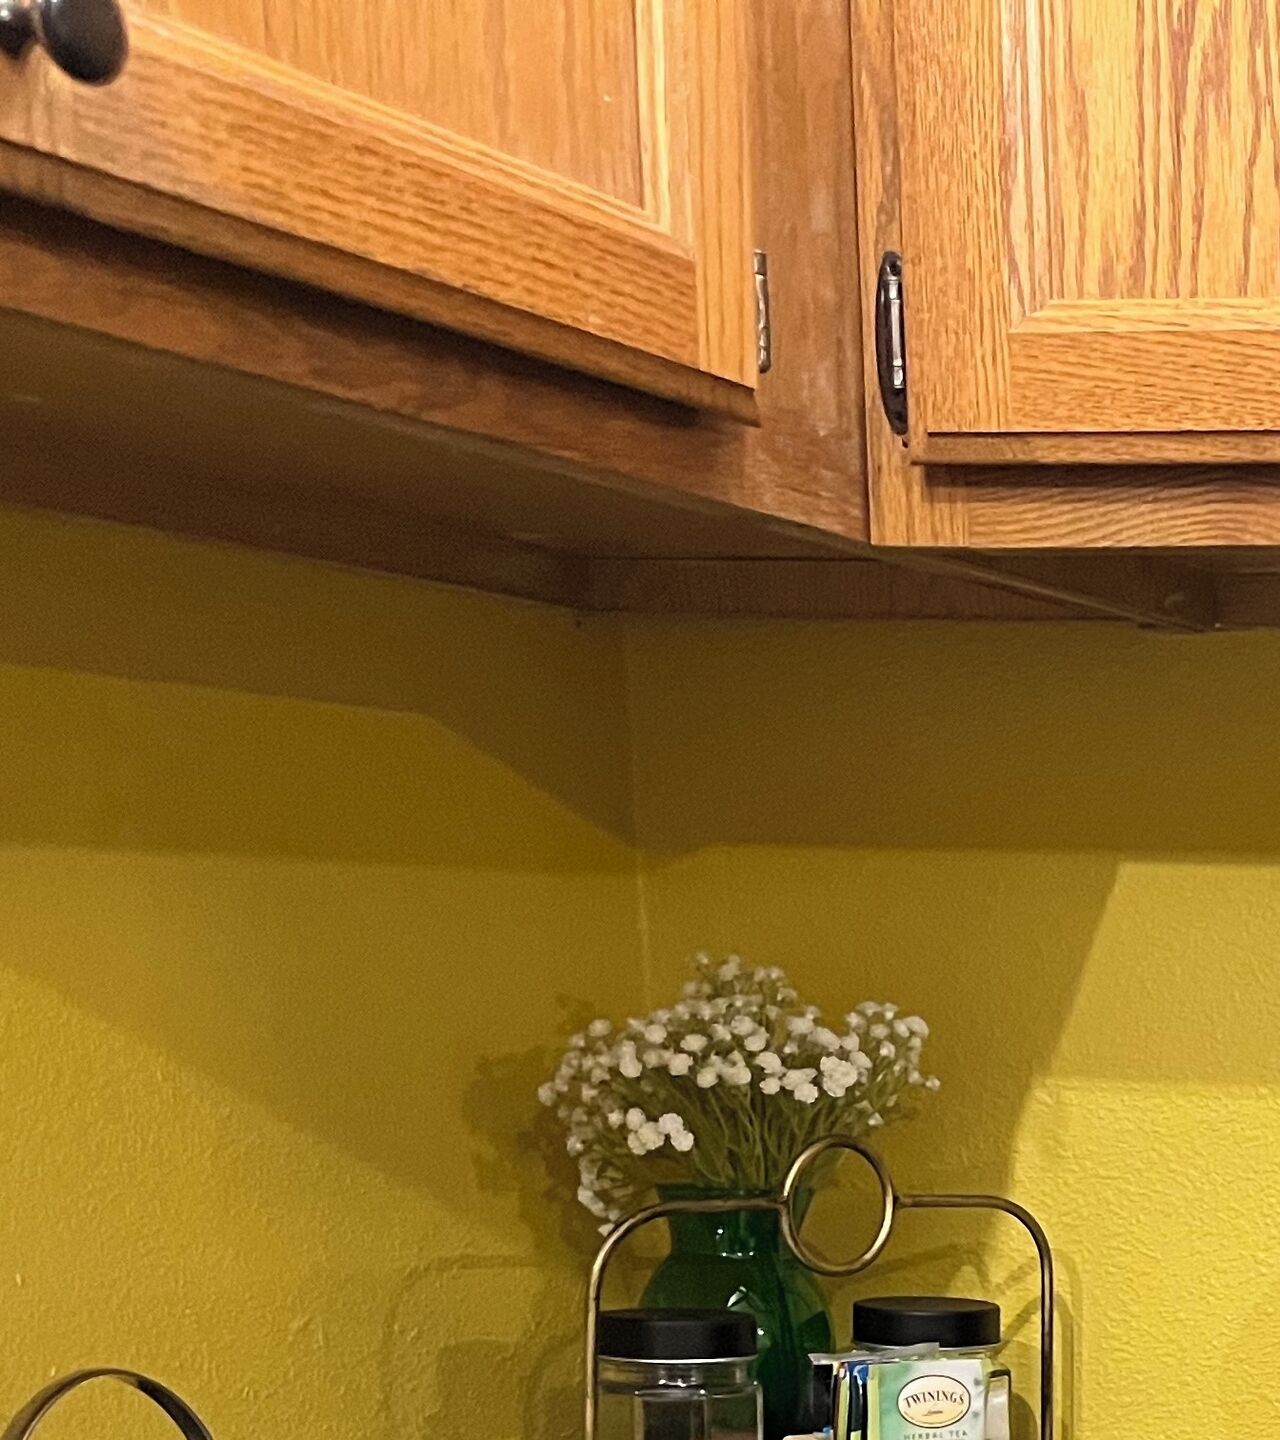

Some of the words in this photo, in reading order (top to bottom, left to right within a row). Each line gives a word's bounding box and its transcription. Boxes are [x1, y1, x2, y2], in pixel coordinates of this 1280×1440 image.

[904, 1390, 965, 1408] TWININGS
[904, 1431, 944, 1440] HERBAL
[949, 1430, 968, 1438] TEA
